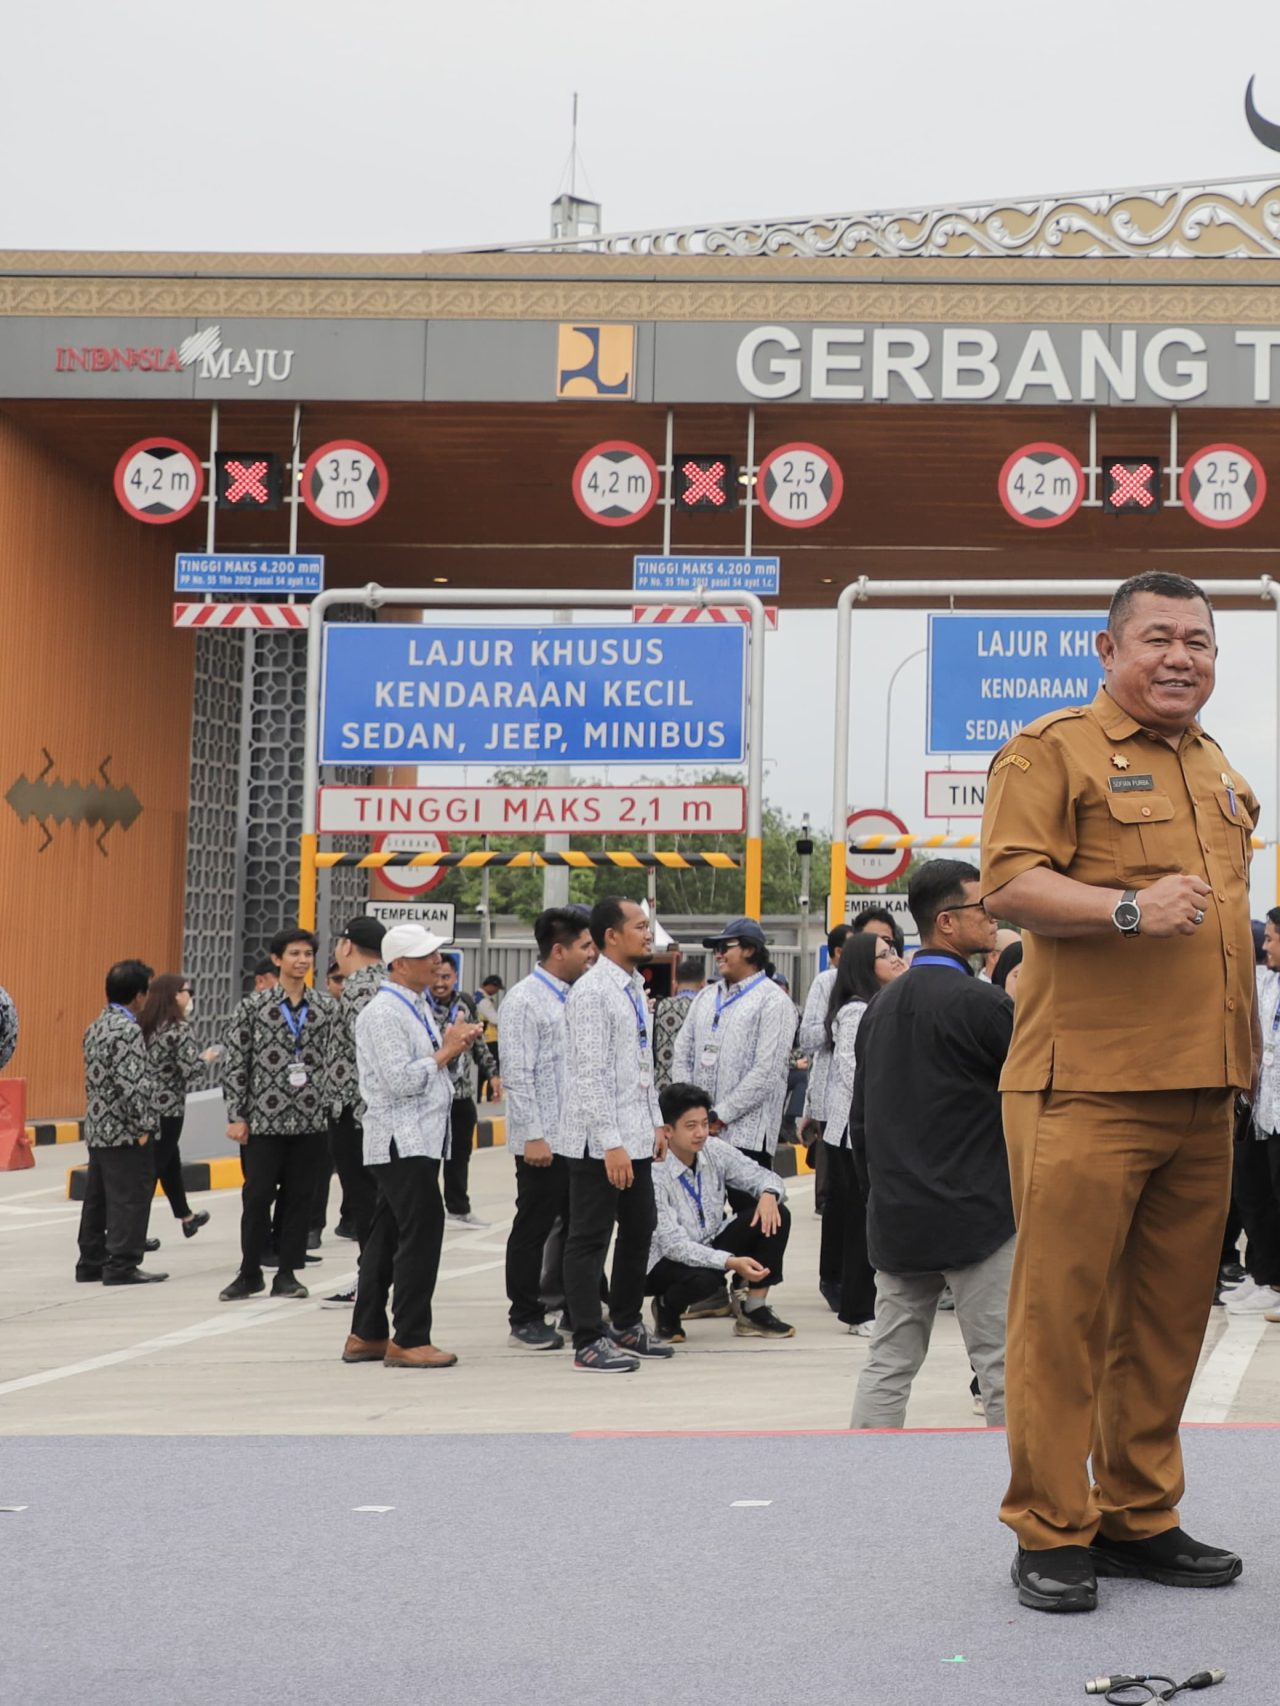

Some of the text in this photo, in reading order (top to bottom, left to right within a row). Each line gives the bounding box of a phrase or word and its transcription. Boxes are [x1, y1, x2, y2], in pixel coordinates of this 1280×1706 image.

[199, 348, 294, 387] MAJU
[736, 327, 1209, 401] GERBANG
[131, 468, 189, 493] 4,2 m
[329, 459, 362, 485] 3,5
[587, 471, 645, 497] 4,2 m
[782, 461, 815, 487] 2,5
[1206, 462, 1239, 487] 2,5
[337, 490, 354, 508] m
[1014, 473, 1071, 499] 4,2 m
[789, 492, 807, 509] m
[1213, 493, 1231, 510] m
[180, 560, 320, 573] TINGGI MAKS 4.200 mm
[638, 562, 776, 575] TINGGI MAKS 4.200 mm
[409, 638, 664, 667] LAJUR KHUSUS
[977, 630, 1047, 657] LAJUR
[375, 680, 694, 708] KENDARAAN KECIL
[981, 678, 1088, 698] KENDARAAN
[341, 721, 725, 754] SEDAN, JEEP, MINIBUS
[354, 797, 712, 826] TINGGI MAKS 2,1 m
[374, 908, 448, 921] TEMPELKAN
